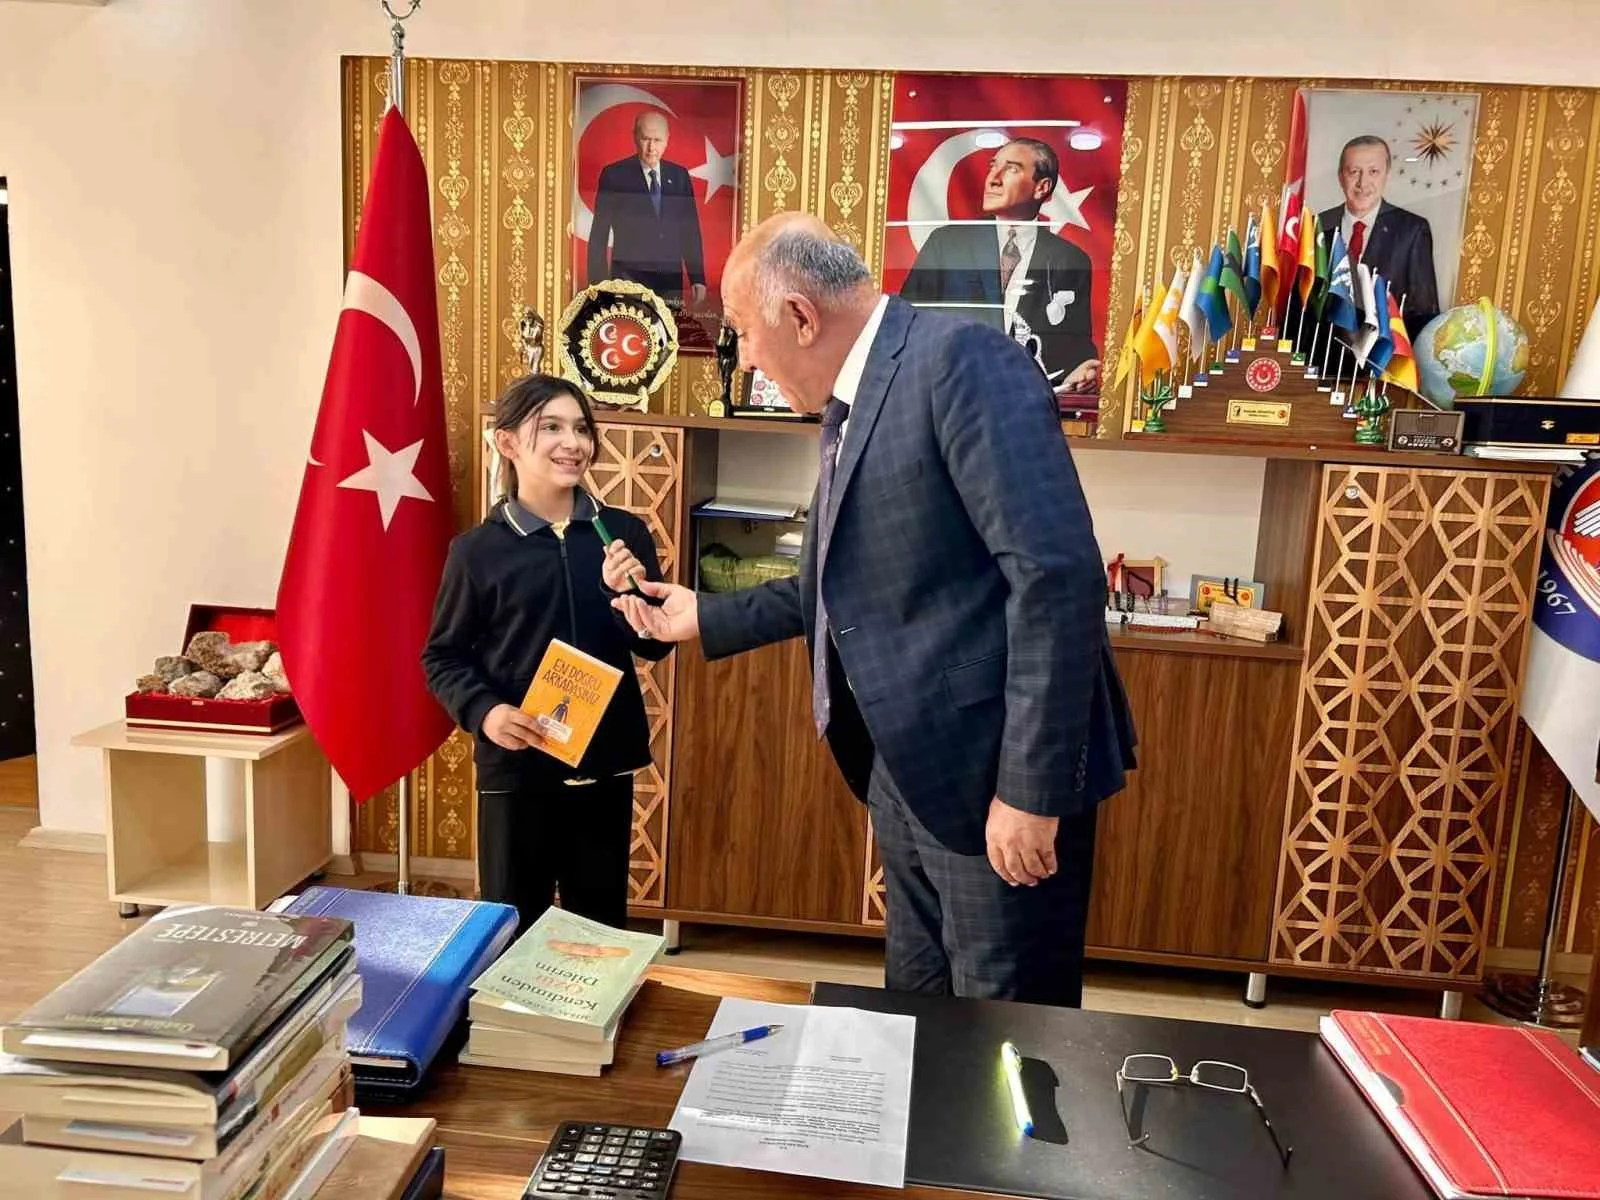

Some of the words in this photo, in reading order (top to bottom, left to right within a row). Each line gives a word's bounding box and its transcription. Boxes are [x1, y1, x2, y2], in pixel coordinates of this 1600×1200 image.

[552, 658, 570, 675] EN
[156, 923, 309, 950] METRESTEPE
[534, 961, 599, 987] Dilerim
[501, 975, 599, 1011] Kendimden
